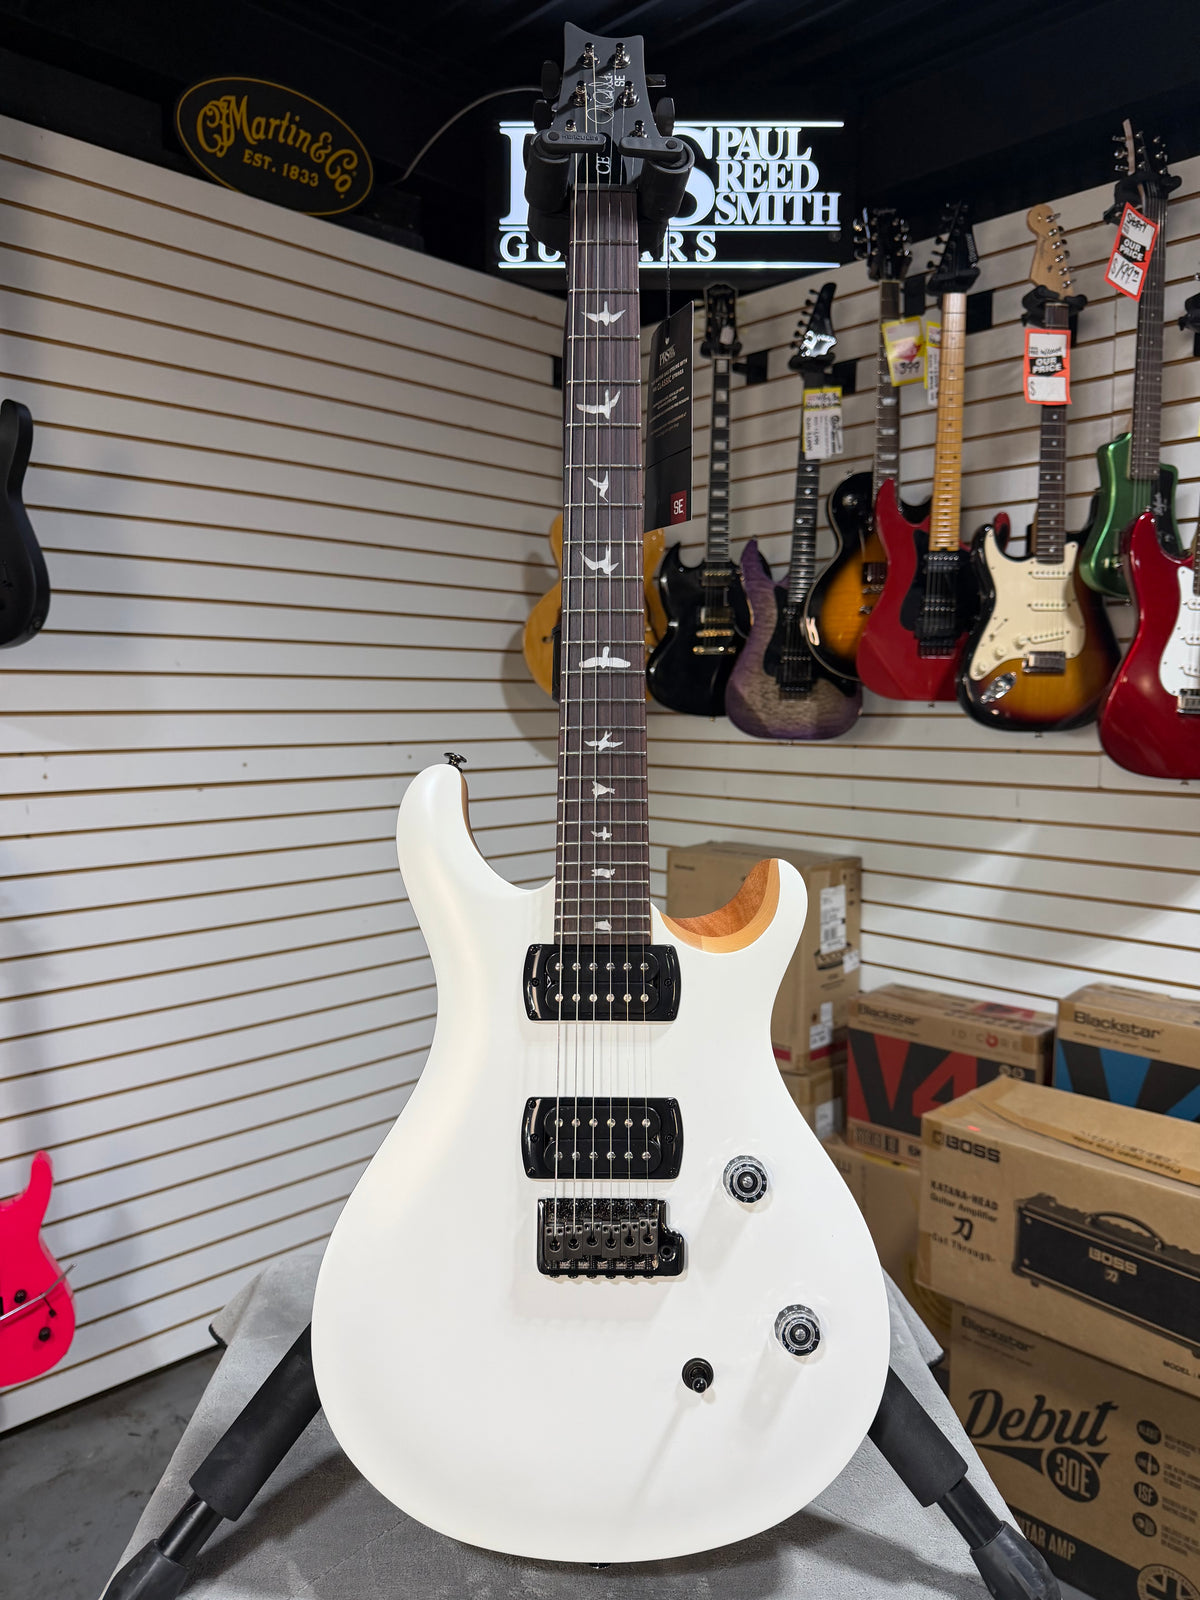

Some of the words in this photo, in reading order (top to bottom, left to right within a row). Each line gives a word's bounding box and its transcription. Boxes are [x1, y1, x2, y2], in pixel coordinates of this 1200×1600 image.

[614, 74, 626, 87] SE
[716, 127, 812, 160] PAUL
[242, 148, 277, 173] EST.
[282, 163, 319, 187] 1833
[716, 160, 820, 193] REED
[714, 191, 842, 225] SMITH
[1119, 244, 1145, 261] PRICE
[1123, 238, 1142, 252] OUR
[1032, 364, 1063, 374] PRICE
[1035, 356, 1057, 367] OUR
[673, 499, 684, 515] SE
[1074, 1011, 1161, 1039] Blackstar
[945, 1134, 1001, 1164] BOSS
[930, 1180, 999, 1212] KATANA-HEAD
[930, 1192, 956, 1208] Guitar
[1088, 1246, 1138, 1276] BOSS
[964, 1389, 1119, 1447] Debut
[1054, 1453, 1093, 1499] 30E
[1047, 1532, 1078, 1561] AMP
